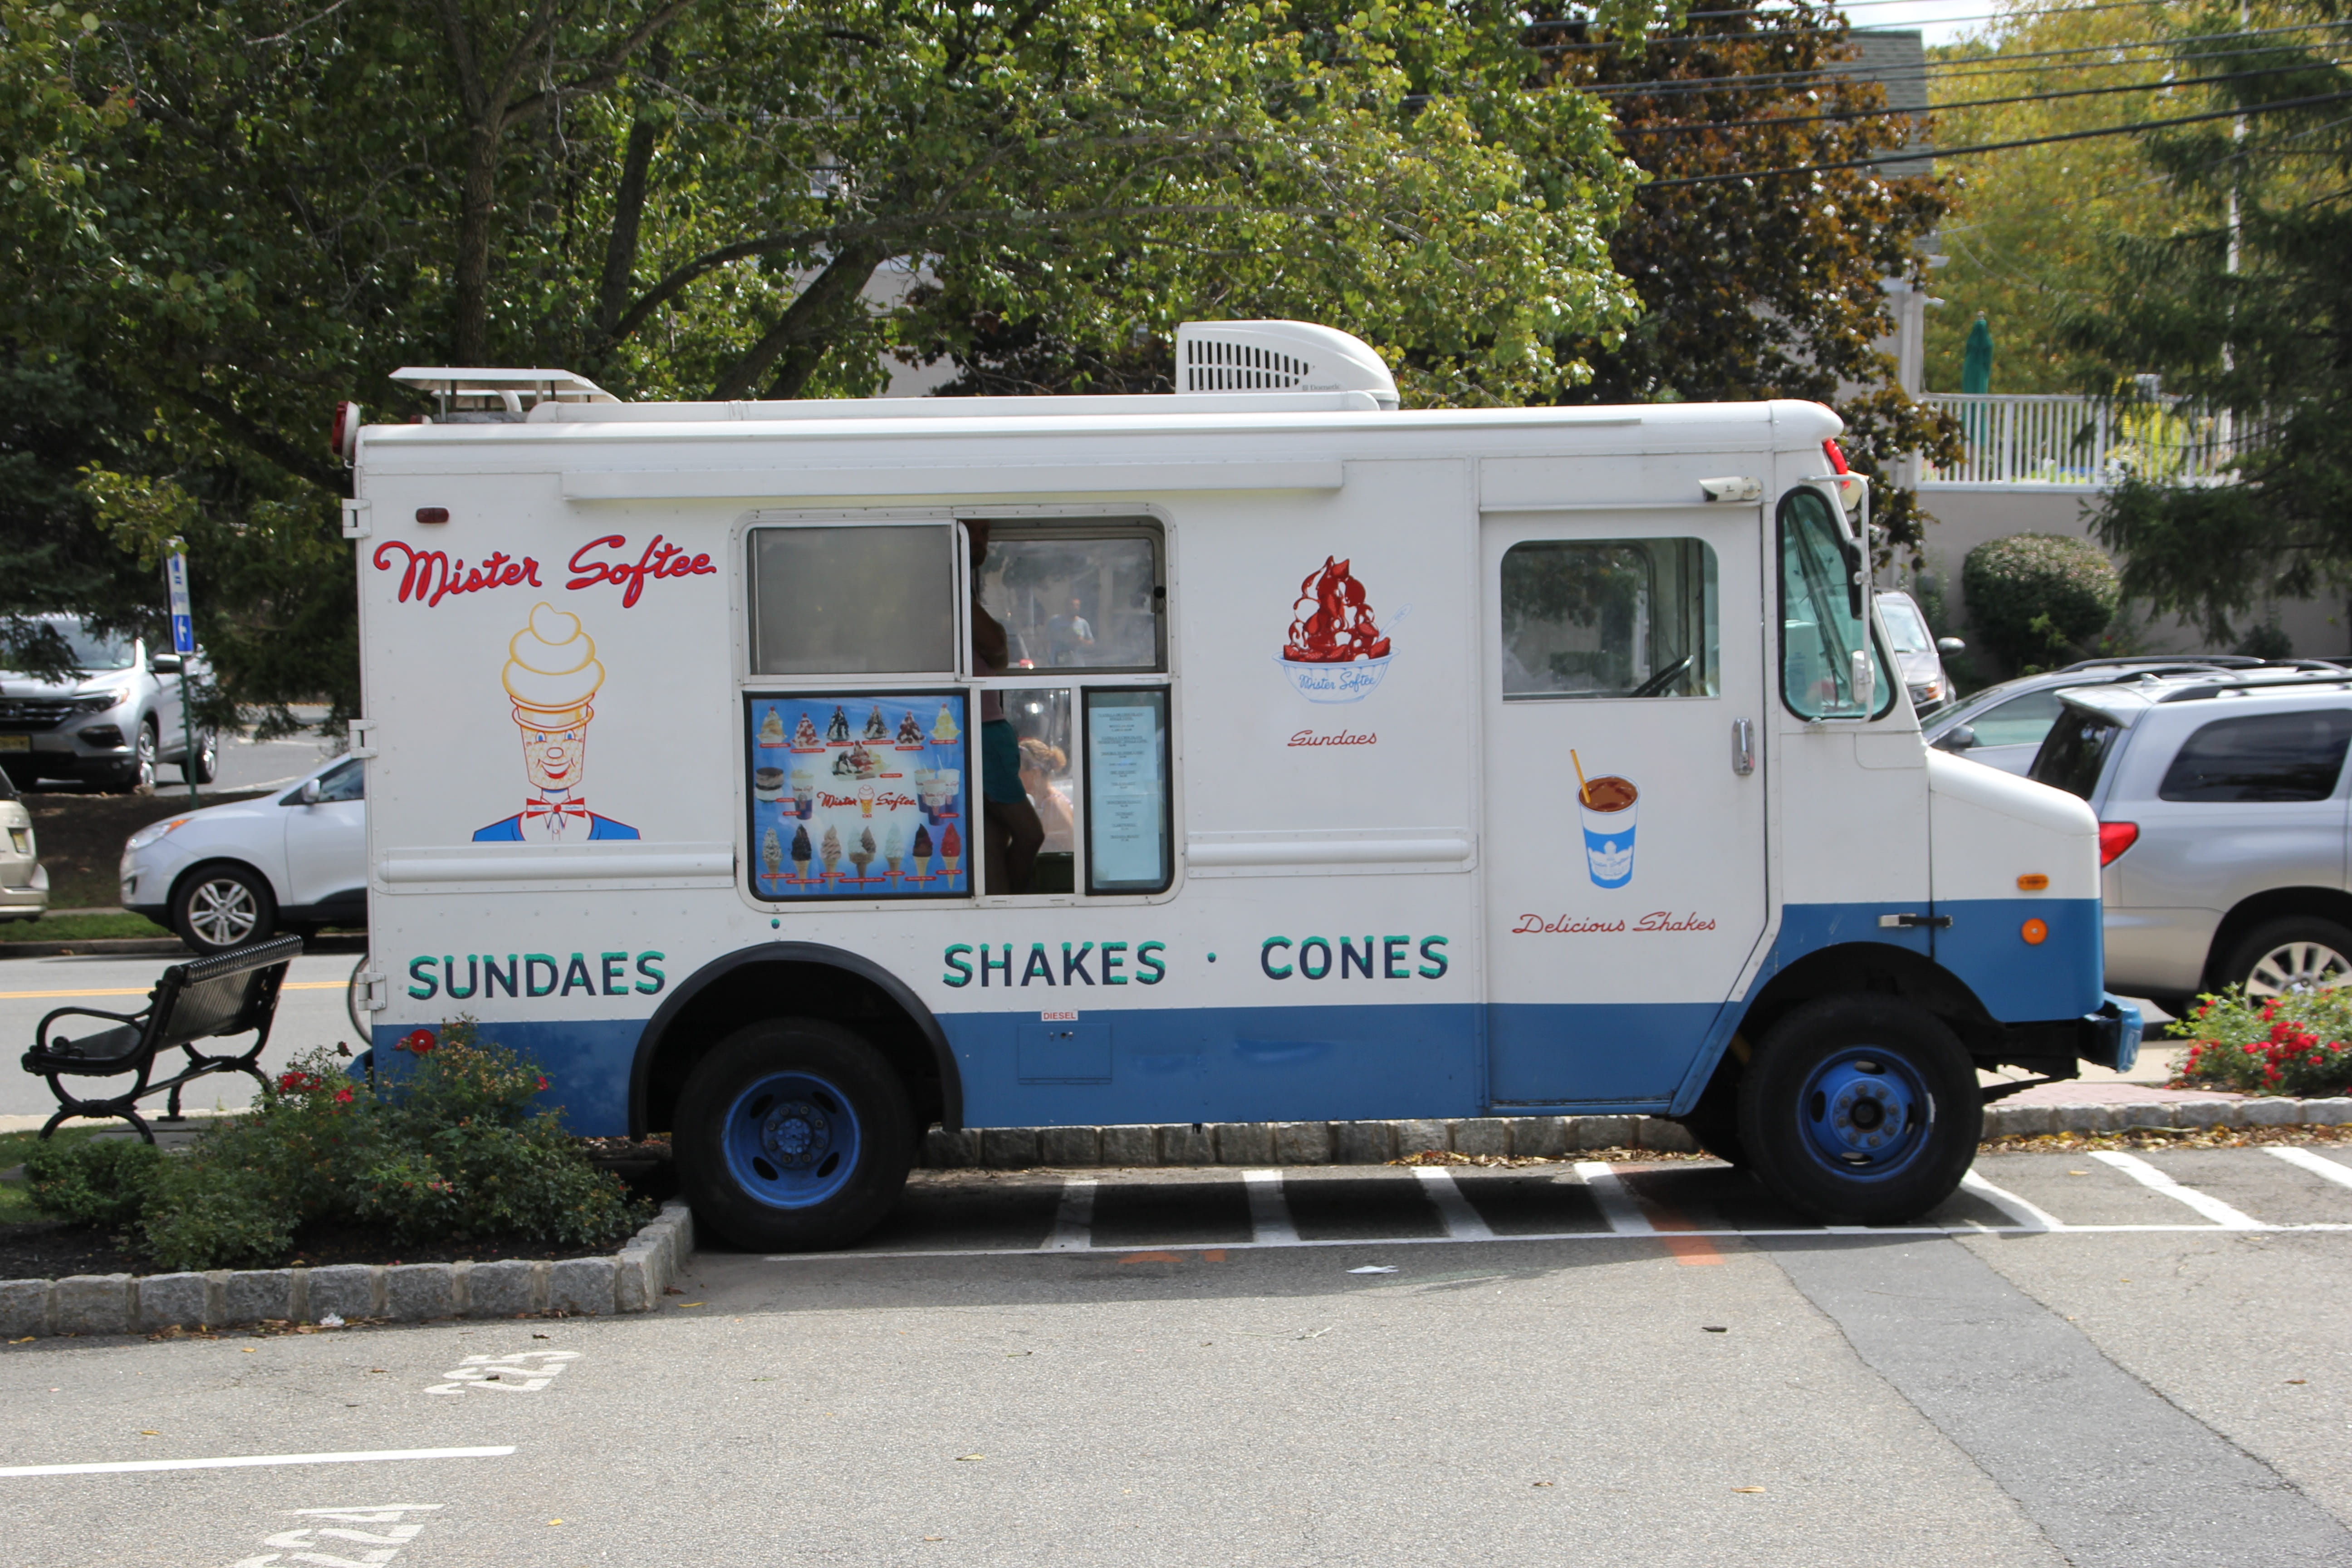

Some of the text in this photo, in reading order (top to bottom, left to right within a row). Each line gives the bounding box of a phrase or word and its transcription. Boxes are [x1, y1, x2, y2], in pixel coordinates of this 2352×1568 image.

[373, 535, 717, 608] Mister Softee
[1299, 671, 1375, 692] Mister Softee
[1287, 729, 1377, 747] Sundaes
[817, 791, 916, 811] Mister Softee
[1512, 911, 1716, 934] Delicious Shakes
[408, 935, 1449, 1000] SUNDAES SHAKES CONES
[423, 1350, 581, 1395] 225
